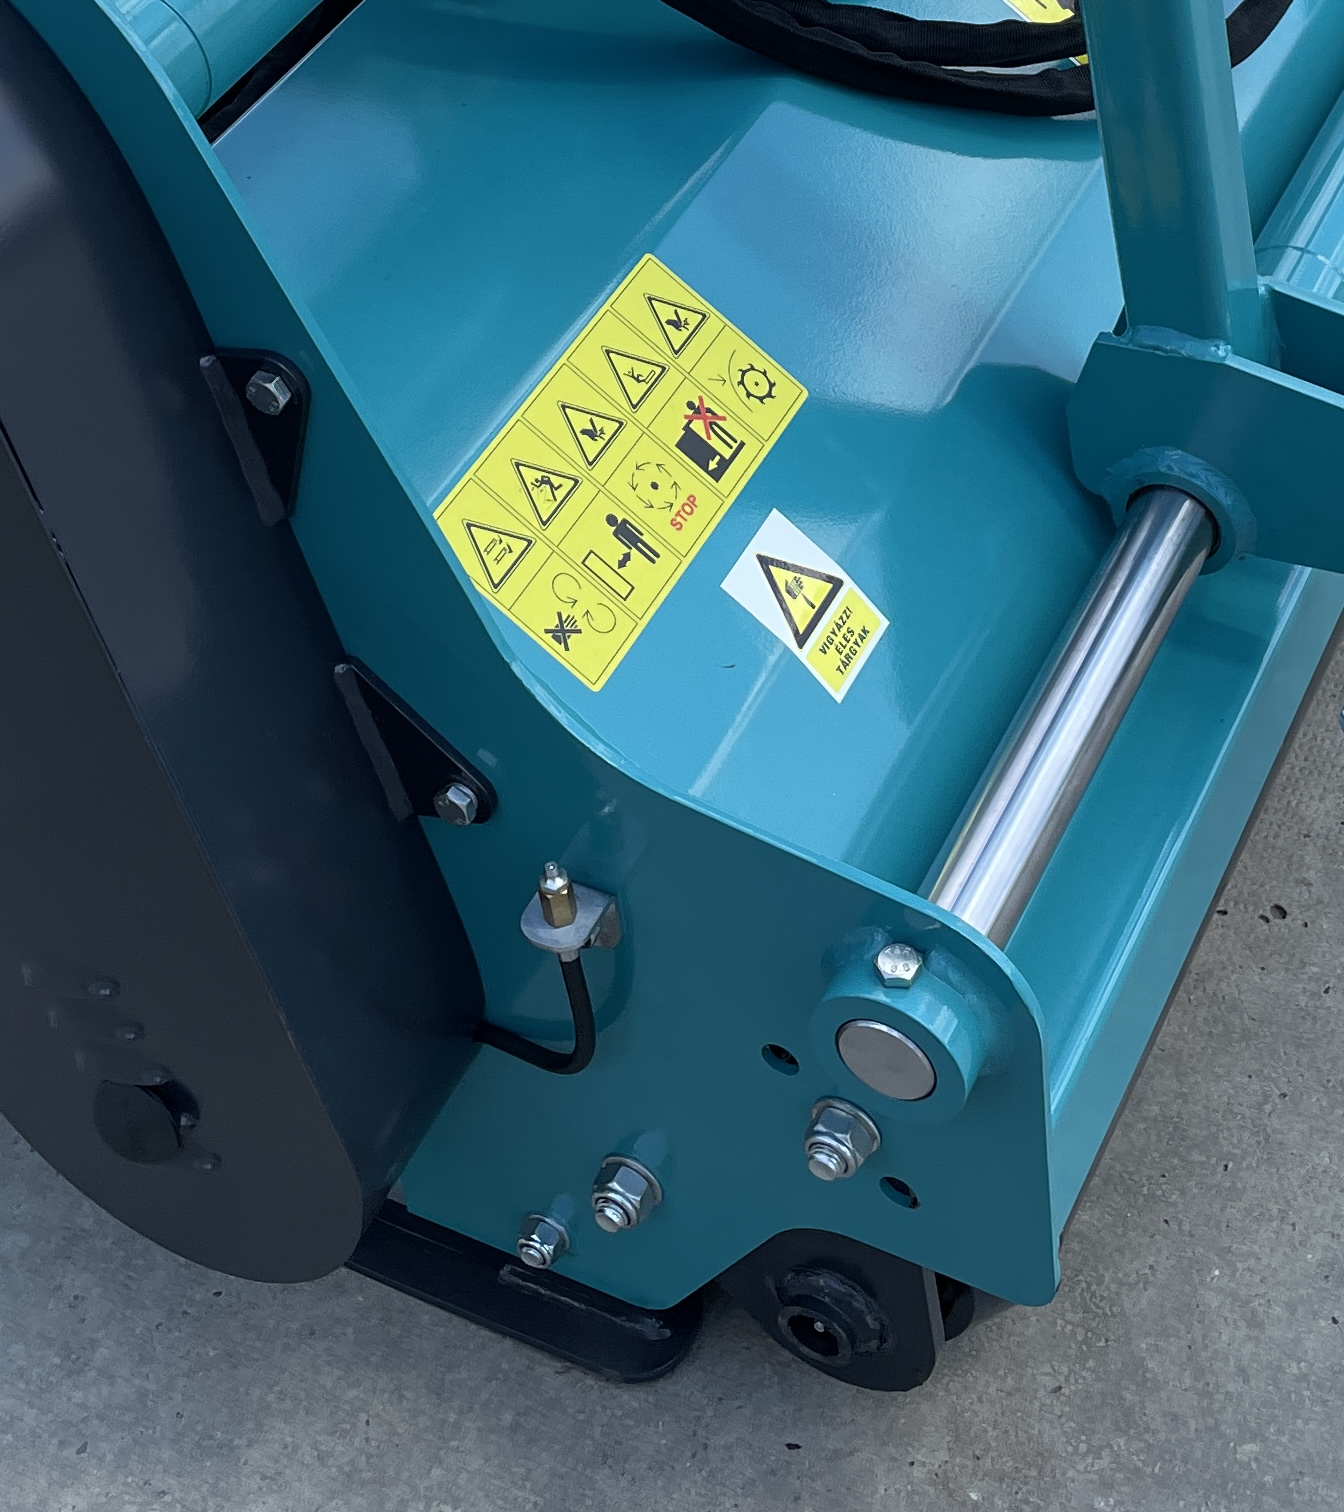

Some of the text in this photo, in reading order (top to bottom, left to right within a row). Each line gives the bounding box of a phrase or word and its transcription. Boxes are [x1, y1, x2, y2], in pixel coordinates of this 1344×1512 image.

[670, 493, 698, 532] STOP
[834, 626, 855, 656] ÉLES
[835, 624, 870, 676] TÁRGYAK
